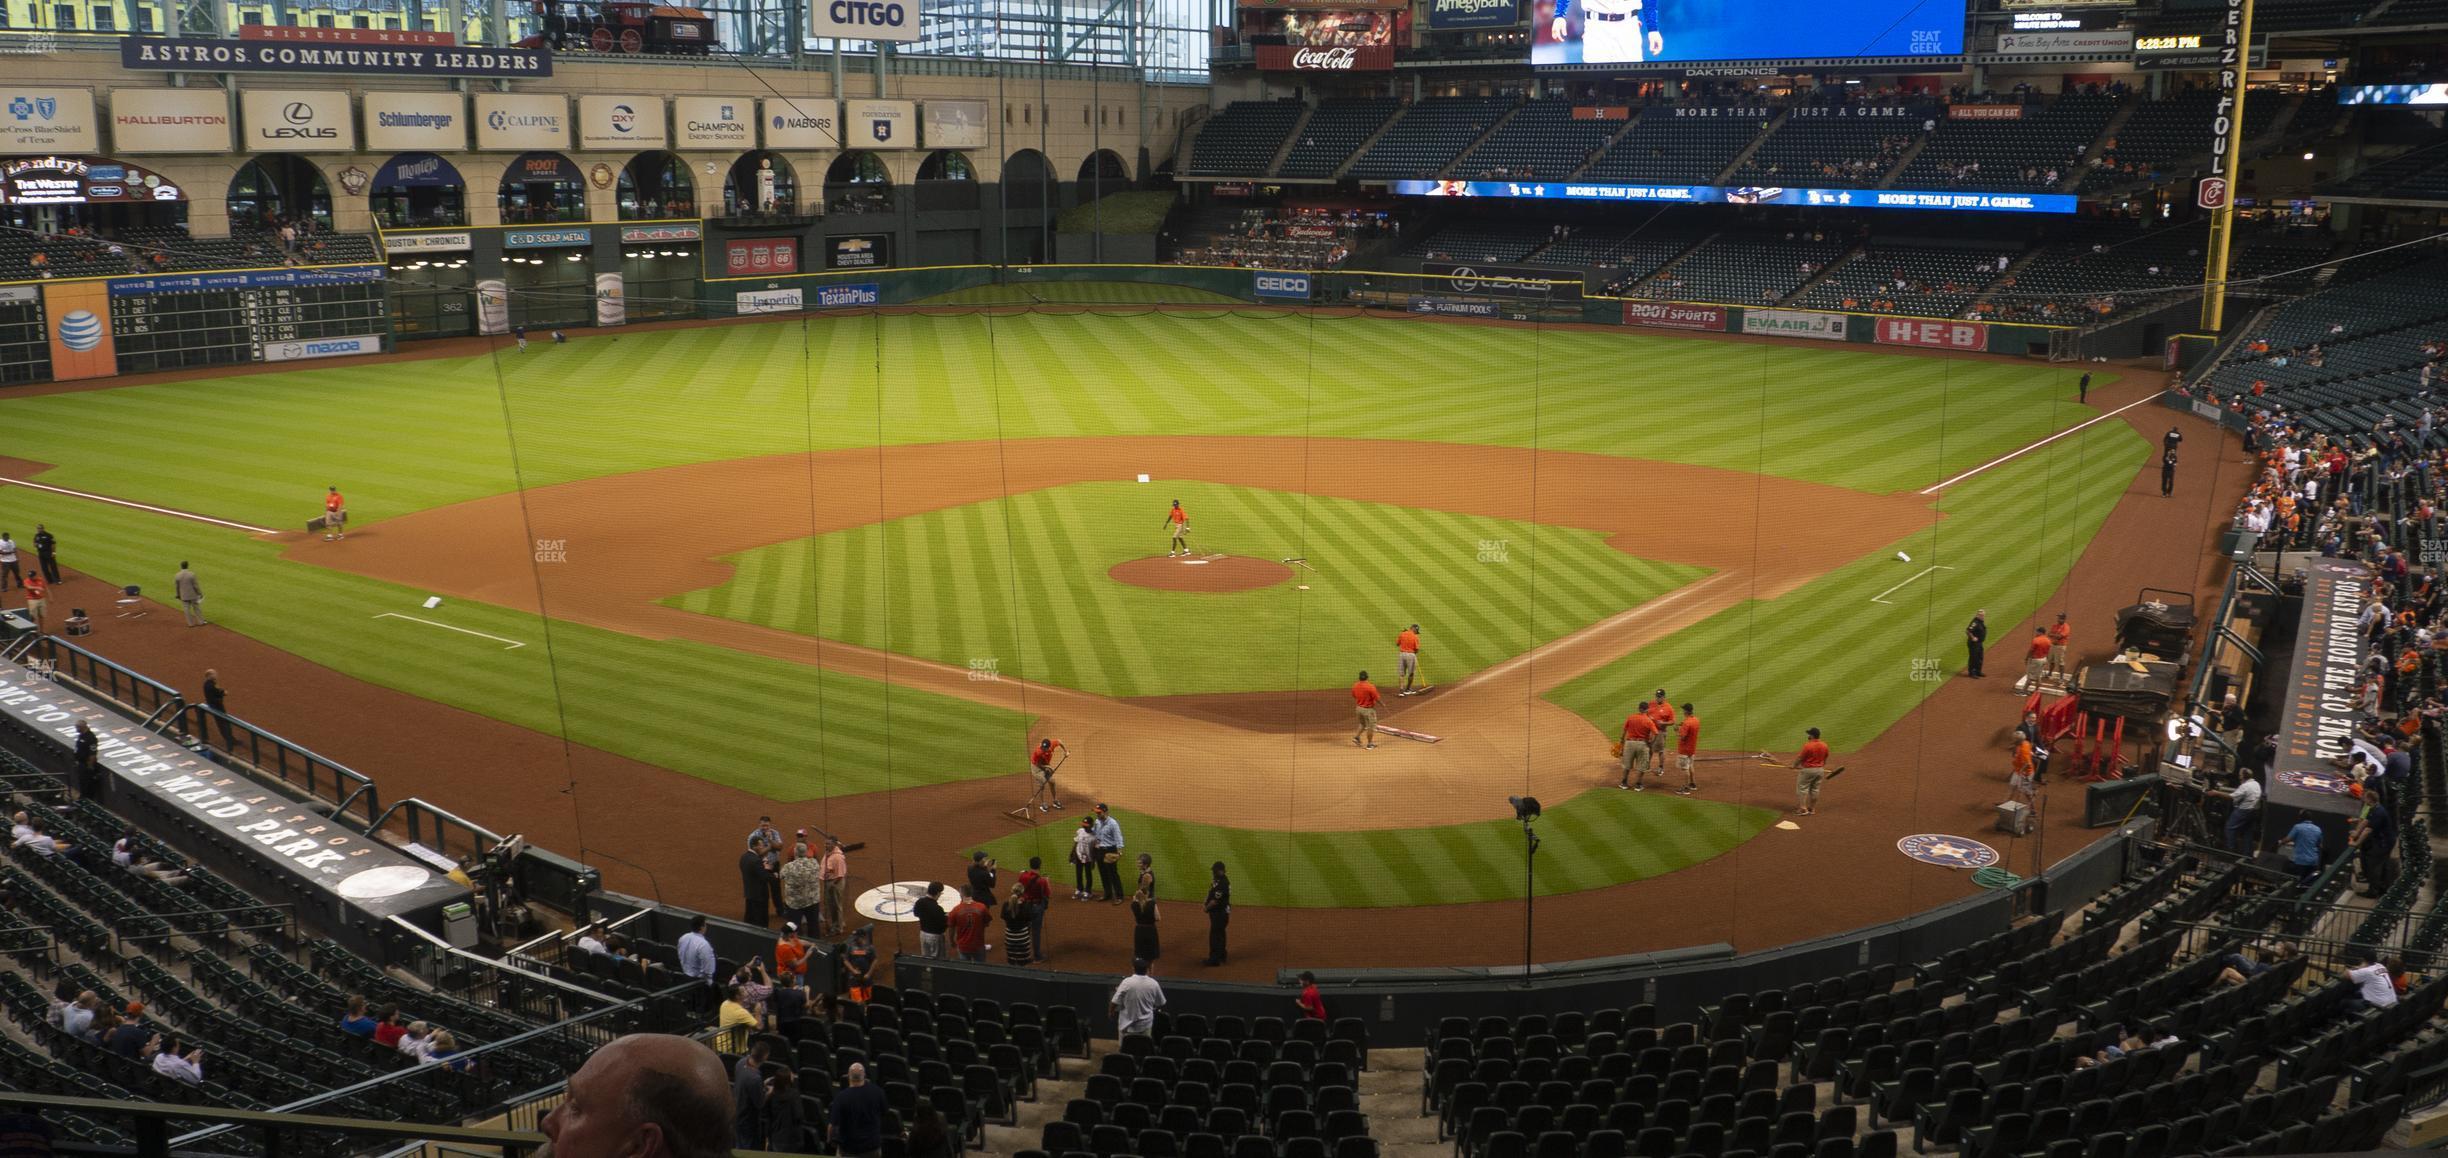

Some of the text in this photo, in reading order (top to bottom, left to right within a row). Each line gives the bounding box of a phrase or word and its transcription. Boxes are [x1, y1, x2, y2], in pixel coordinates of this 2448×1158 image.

[829, 0, 905, 27] CITGO
[264, 29, 436, 42] MINUTE MAID
[2178, 36, 2201, 48] PM
[140, 45, 539, 70] ASTROS COMMUNITY LEADERS
[2159, 57, 2179, 65] HOME
[1686, 67, 1779, 77] DAKTRONICS
[612, 114, 636, 123] OXY
[1675, 108, 1719, 117] MORE
[1727, 107, 1768, 117] THAN
[1792, 107, 1829, 118] JUST
[1838, 107, 1848, 117] A
[1958, 108, 2019, 118] ALL YOU CAN EAT
[117, 115, 226, 126] HALLIBURTON
[379, 111, 453, 130] Schlumberger
[507, 115, 560, 126] CALPINE
[787, 117, 831, 130] NABORS
[35, 125, 82, 133] BlueShield
[262, 127, 338, 139] LEXUS
[17, 136, 56, 144] of Texas
[7, 156, 89, 176] Landry's
[397, 157, 439, 180] Montejo
[526, 159, 560, 171] ROOT
[1566, 186, 1599, 197] MORE
[1599, 186, 1626, 198] THAN
[1626, 187, 1649, 199] JUST
[1649, 188, 1658, 198] A
[1878, 193, 1917, 205] MORE
[1917, 194, 1951, 206] THAN
[1952, 196, 1979, 208] JUST
[1979, 197, 1990, 207] A
[536, 233, 561, 243] SCRAP
[562, 232, 585, 242] METAL
[1289, 226, 1334, 237] Budweiser
[384, 235, 466, 248] OUSTON CHRONICLE
[732, 254, 789, 265] 66 66 66
[1257, 276, 1308, 292] GEICO
[820, 289, 877, 306] TexanPlus
[443, 303, 463, 313] 362
[1436, 303, 1492, 314] PLATINUM POOLS
[1632, 303, 1717, 322] ROOT SPORTS
[1747, 316, 1810, 331] EVA AIR
[306, 341, 361, 355] mazda
[2332, 580, 2362, 614] ASTROS
[2326, 614, 2359, 665] HOUSTON
[2323, 667, 2357, 691] THE
[2320, 693, 2354, 713] OF
[2315, 716, 2353, 759] HOME
[22, 703, 71, 722] TO
[154, 775, 250, 818] MAID
[21, 680, 371, 857] OF THE HOUSTON ASTROS
